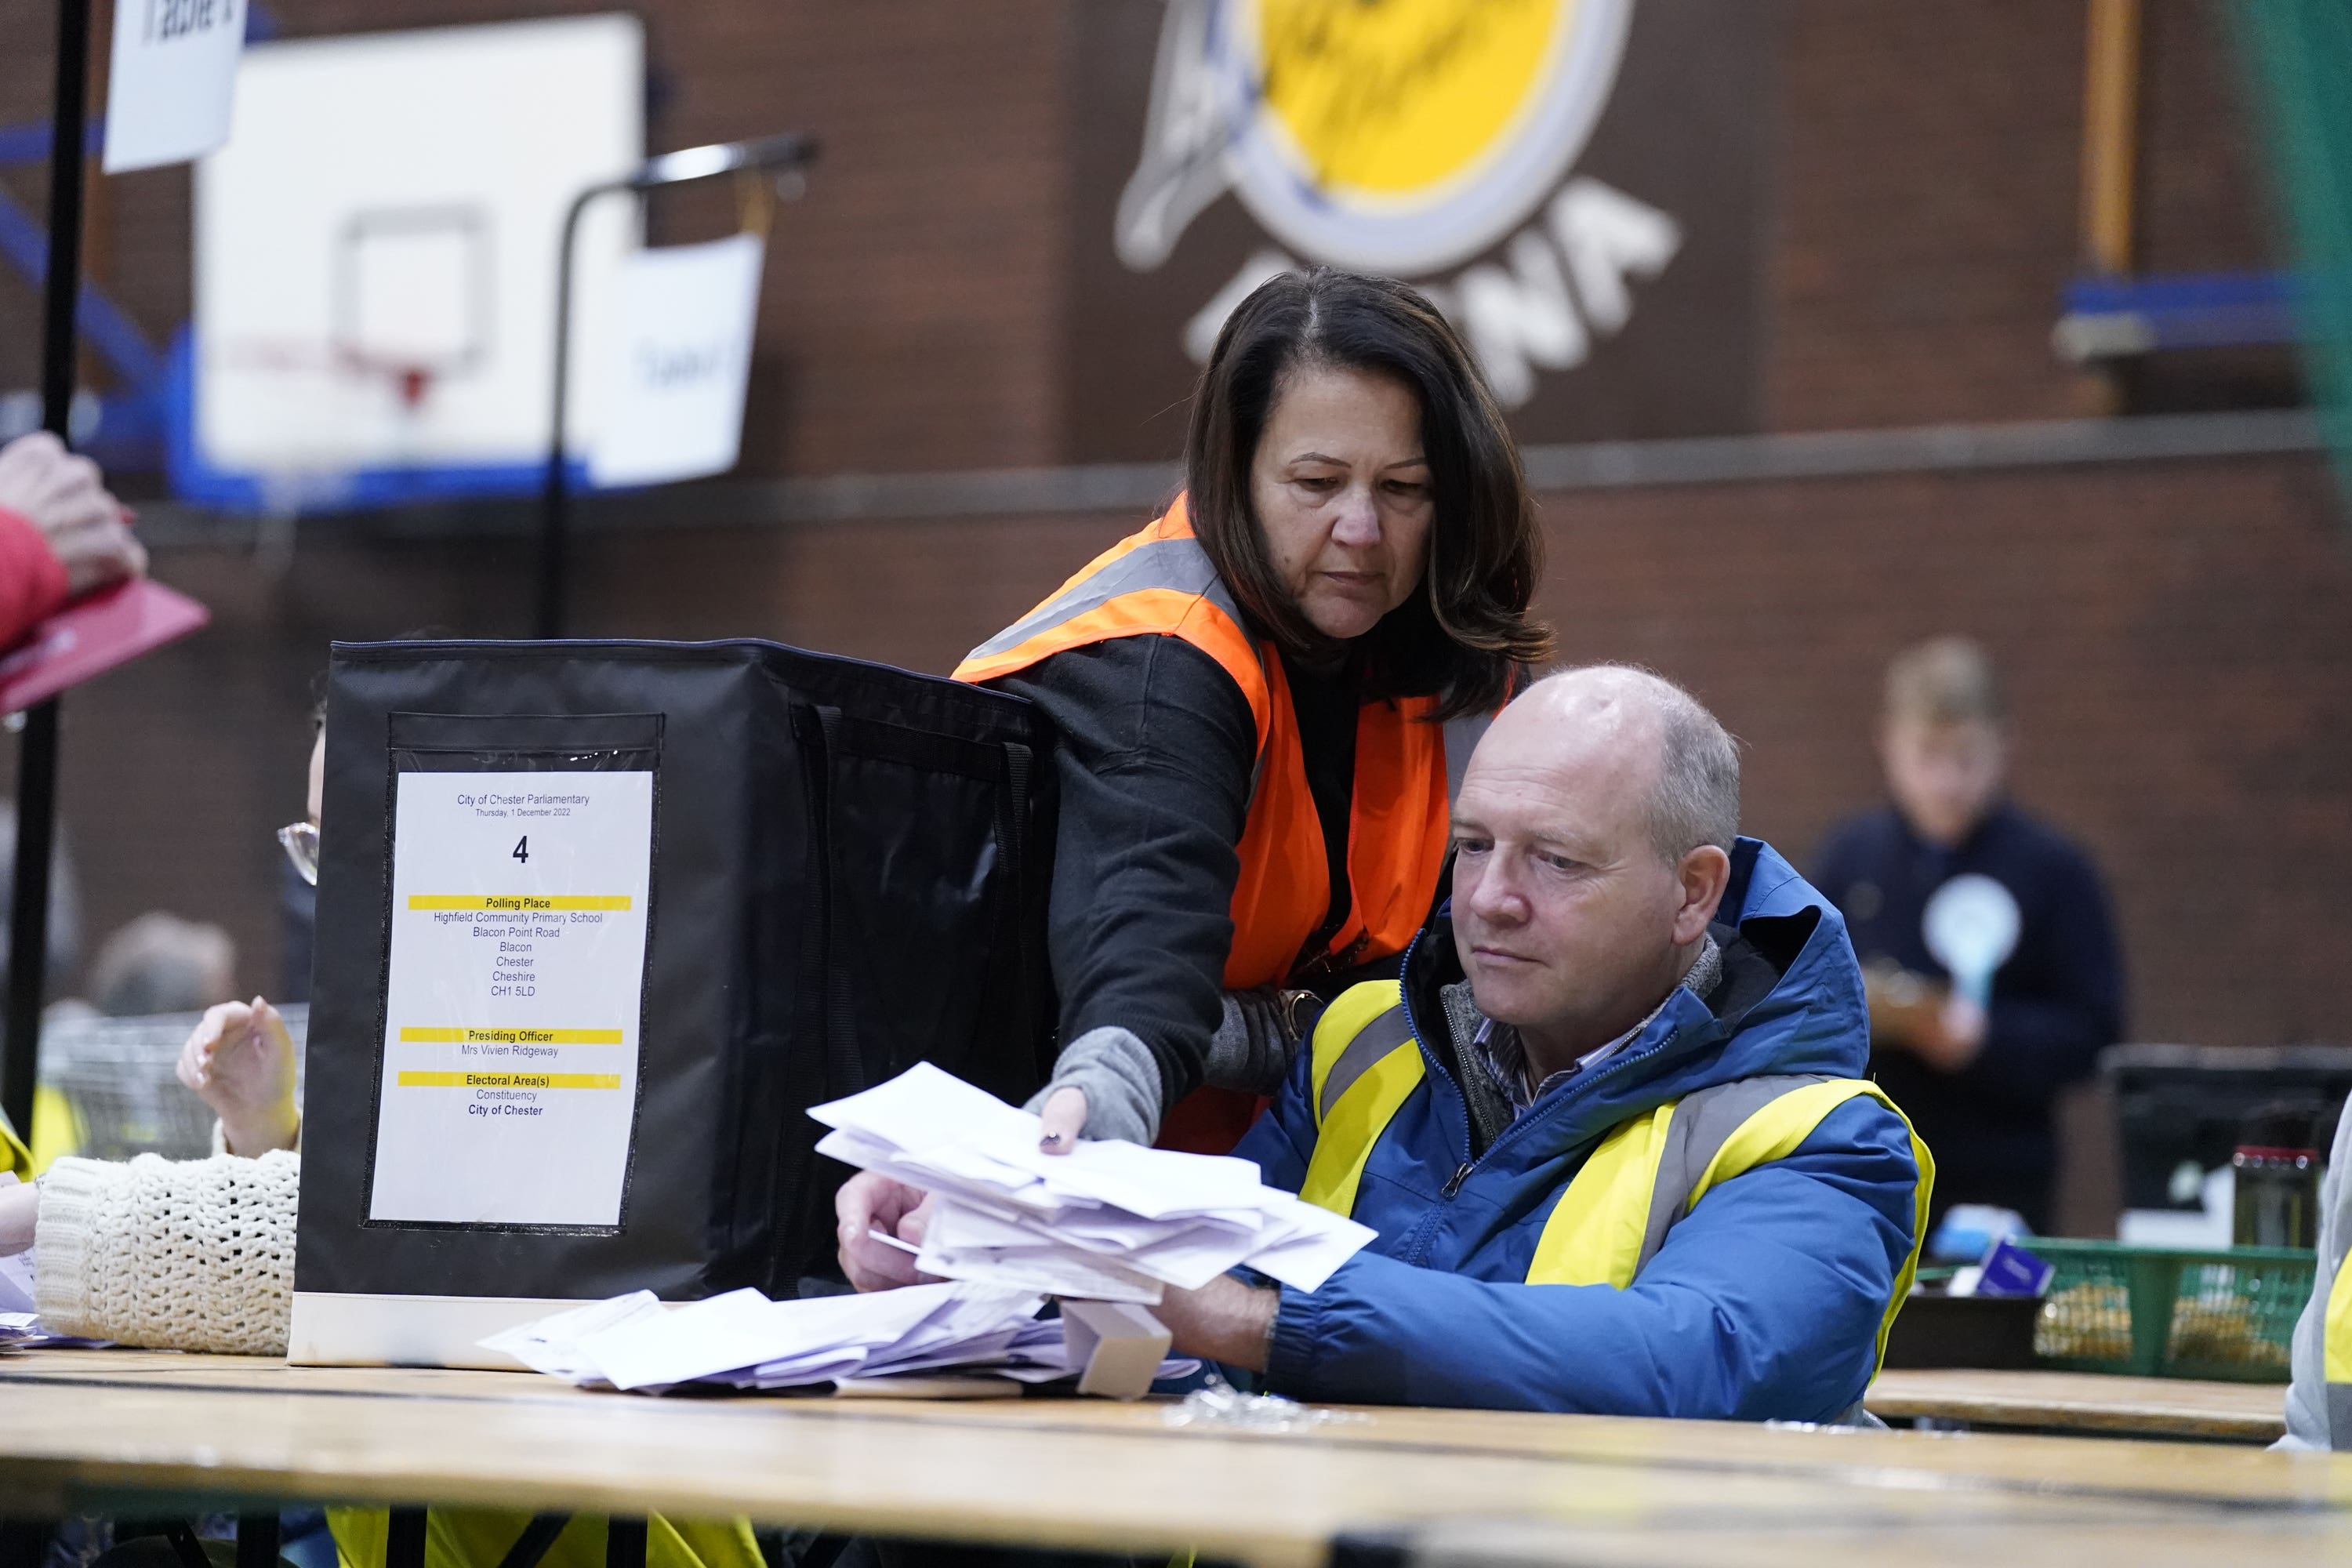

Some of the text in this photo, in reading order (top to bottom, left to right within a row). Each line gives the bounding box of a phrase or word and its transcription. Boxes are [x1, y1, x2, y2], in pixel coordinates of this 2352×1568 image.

[457, 793, 590, 808] City of Chester Parliamentary
[475, 808, 509, 818] Thursday,
[517, 808, 552, 817] December
[553, 808, 571, 816] 2022
[513, 836, 528, 863] 4
[486, 898, 551, 911] Polling Place
[434, 911, 603, 925] Highfield Community Primary School
[473, 926, 561, 938] Blacon Point Road
[499, 941, 532, 953] Blacon
[495, 956, 535, 967] Chester
[492, 971, 535, 982] Cheshire
[491, 985, 535, 996] CH1 5LD
[469, 1030, 554, 1044] Presiding Officer
[461, 1044, 559, 1059] Mrs Vivien Ridgeway
[466, 1074, 550, 1088] Electoral Area(s)
[476, 1089, 537, 1103] Constituency
[468, 1104, 543, 1117] City of Chester
